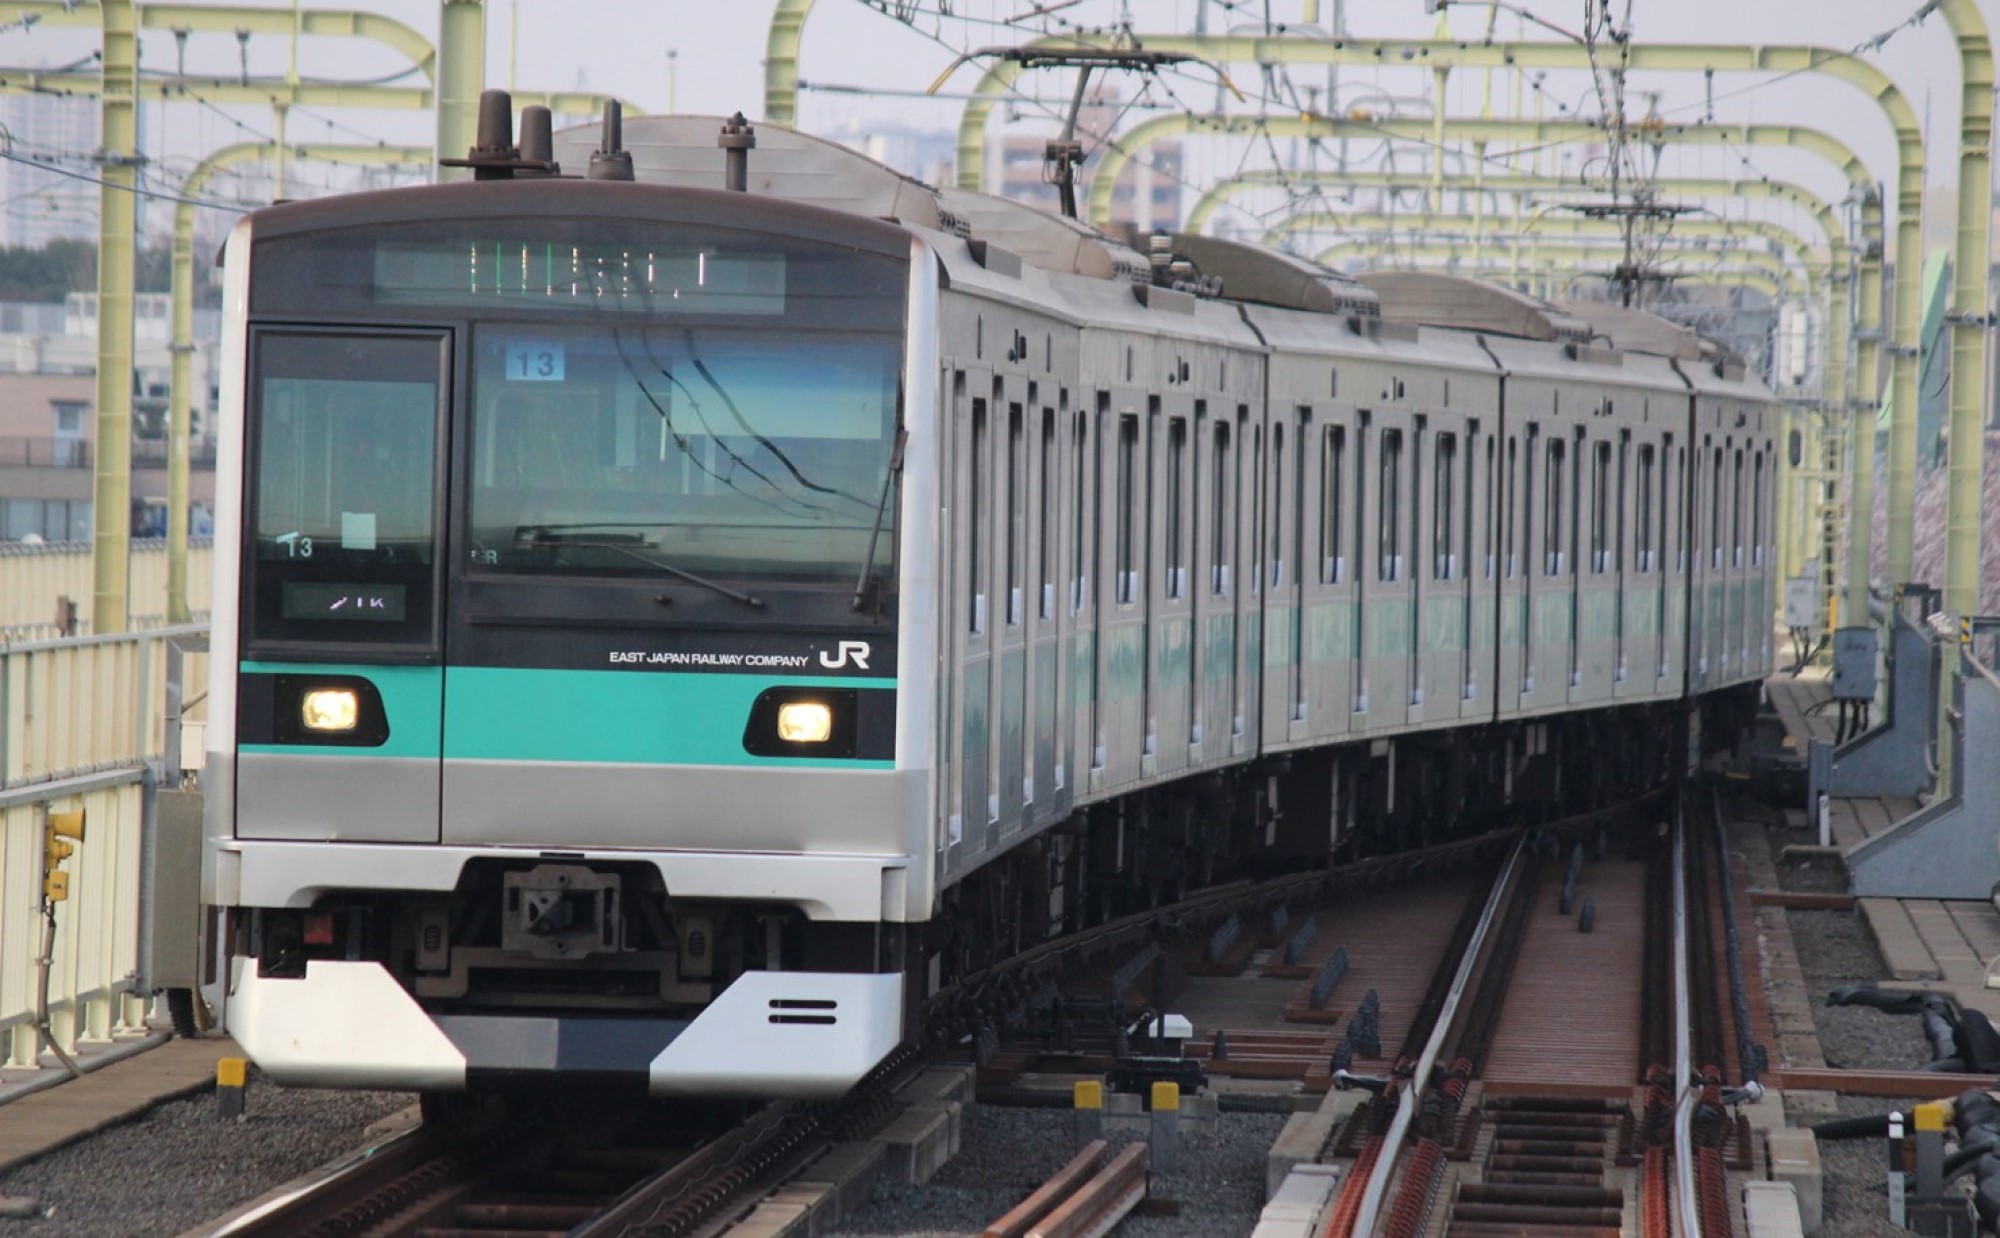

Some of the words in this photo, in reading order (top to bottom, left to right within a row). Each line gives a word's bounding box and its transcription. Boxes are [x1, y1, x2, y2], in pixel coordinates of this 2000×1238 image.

[517, 351, 554, 377] 13
[287, 537, 312, 557] 13
[609, 651, 646, 663] EAST
[646, 652, 690, 664] JAPAN
[691, 653, 744, 666] RAILWAY
[745, 654, 809, 667] COMPANY
[819, 640, 870, 670] JR
